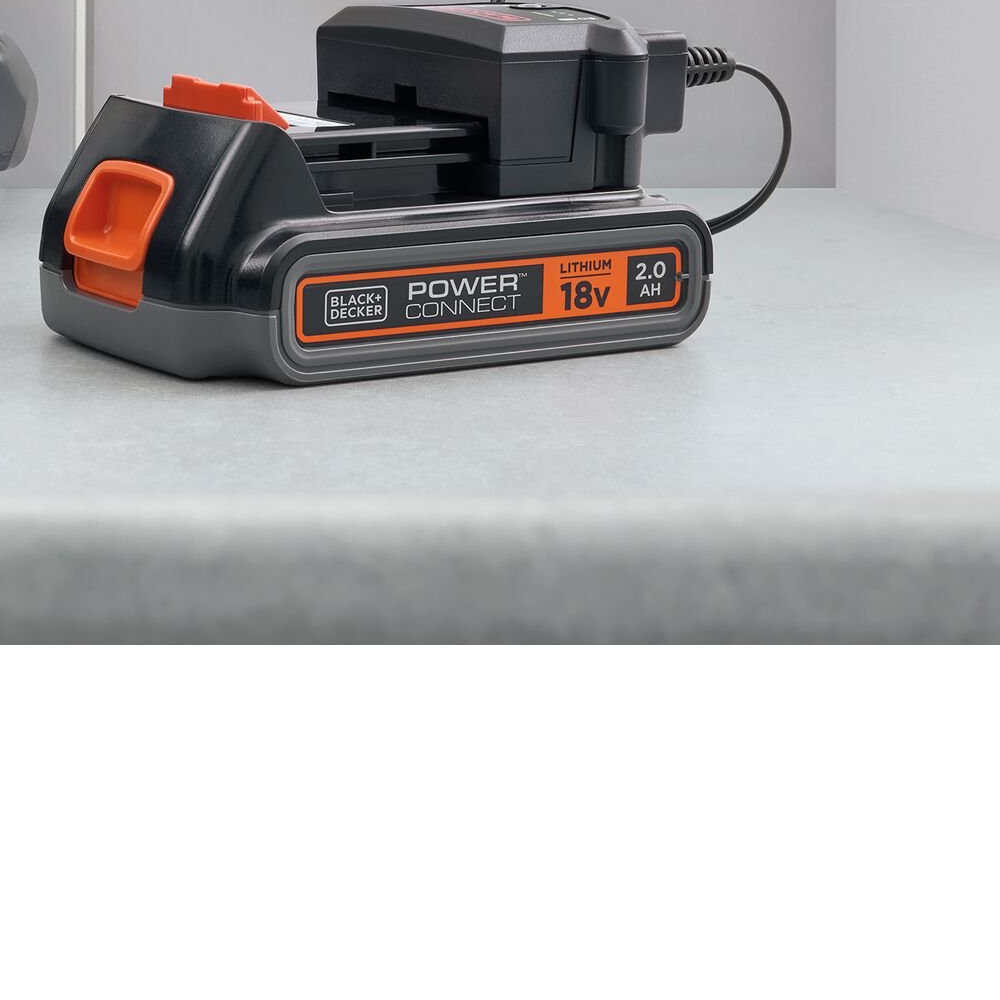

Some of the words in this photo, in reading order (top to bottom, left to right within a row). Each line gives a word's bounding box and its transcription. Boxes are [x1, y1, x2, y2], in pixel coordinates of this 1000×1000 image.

[559, 259, 612, 274] LITHIUM
[635, 261, 667, 281] 2.0
[639, 283, 662, 298] AH
[330, 304, 383, 318] DECKER
[405, 294, 521, 320] CONNECT
